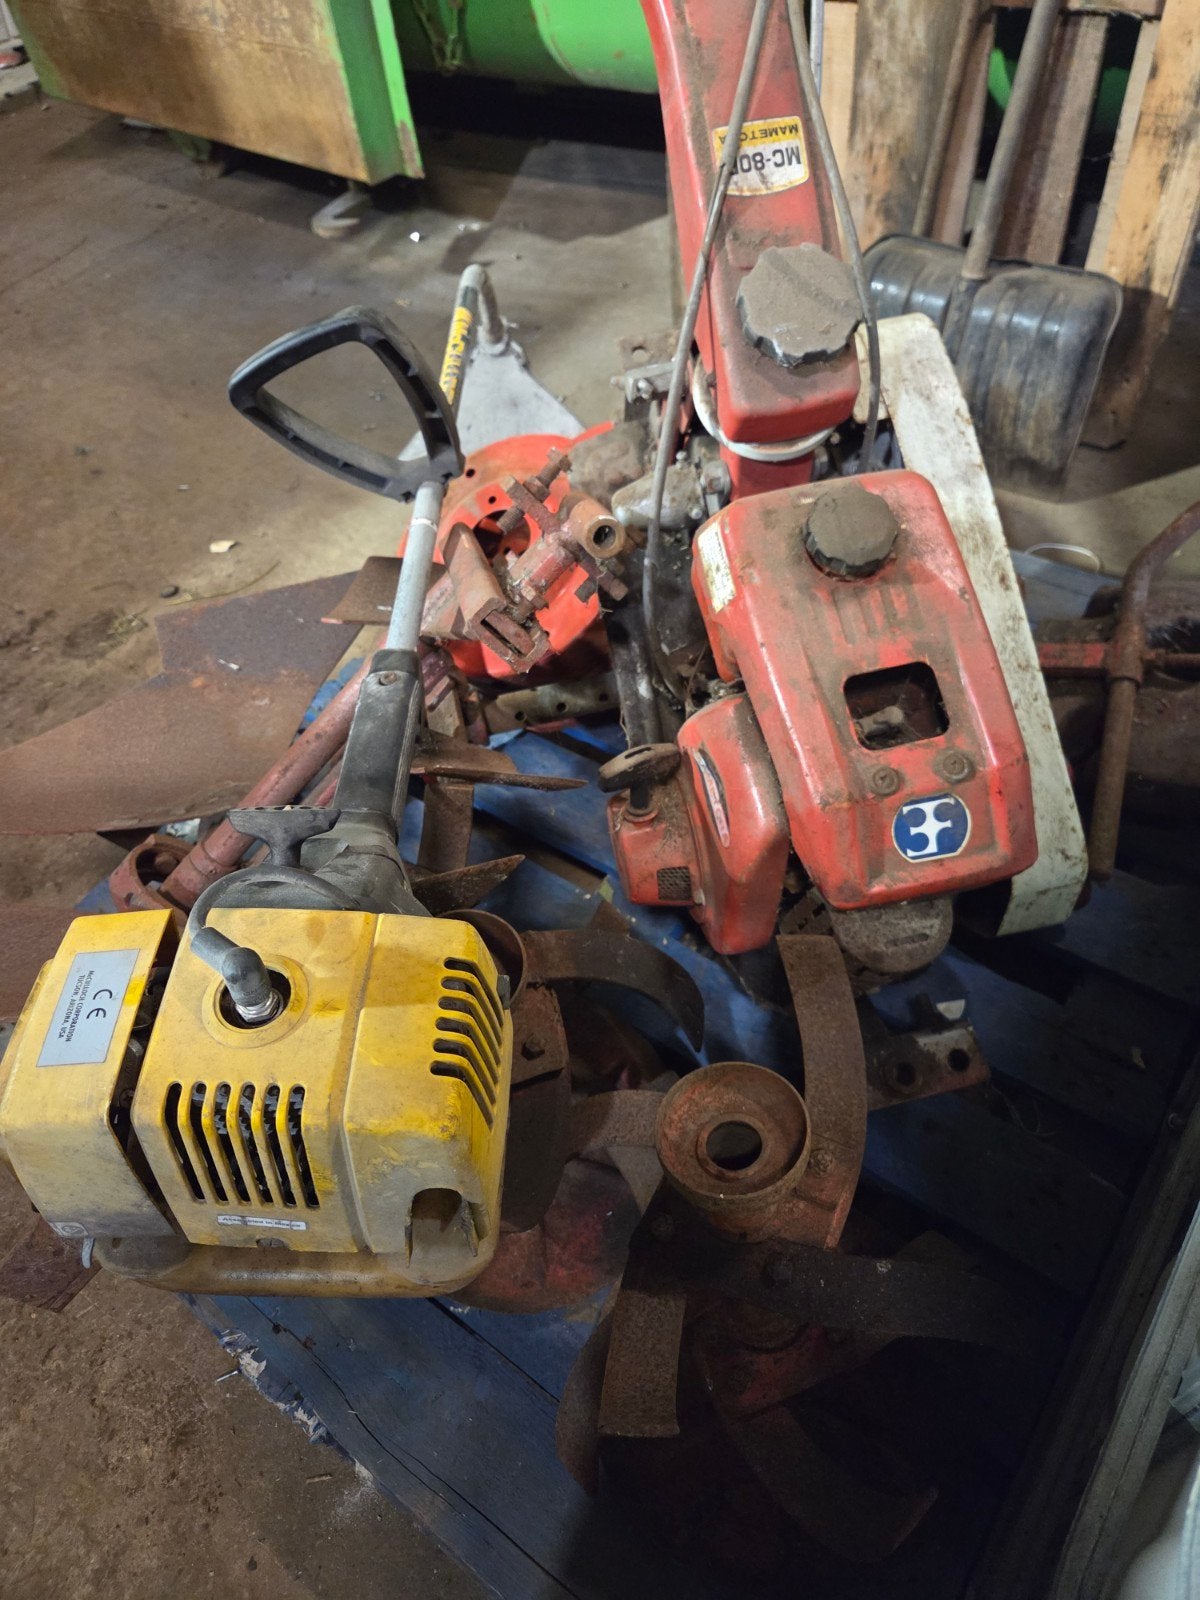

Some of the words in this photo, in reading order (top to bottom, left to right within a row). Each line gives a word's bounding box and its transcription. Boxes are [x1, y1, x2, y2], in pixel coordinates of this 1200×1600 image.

[718, 123, 799, 145] MAMETOA
[71, 974, 86, 998] TUCSON,
[61, 998, 77, 1025] ARIZONA,
[65, 1002, 83, 1042] CORPORATION
[58, 1026, 67, 1039] USA
